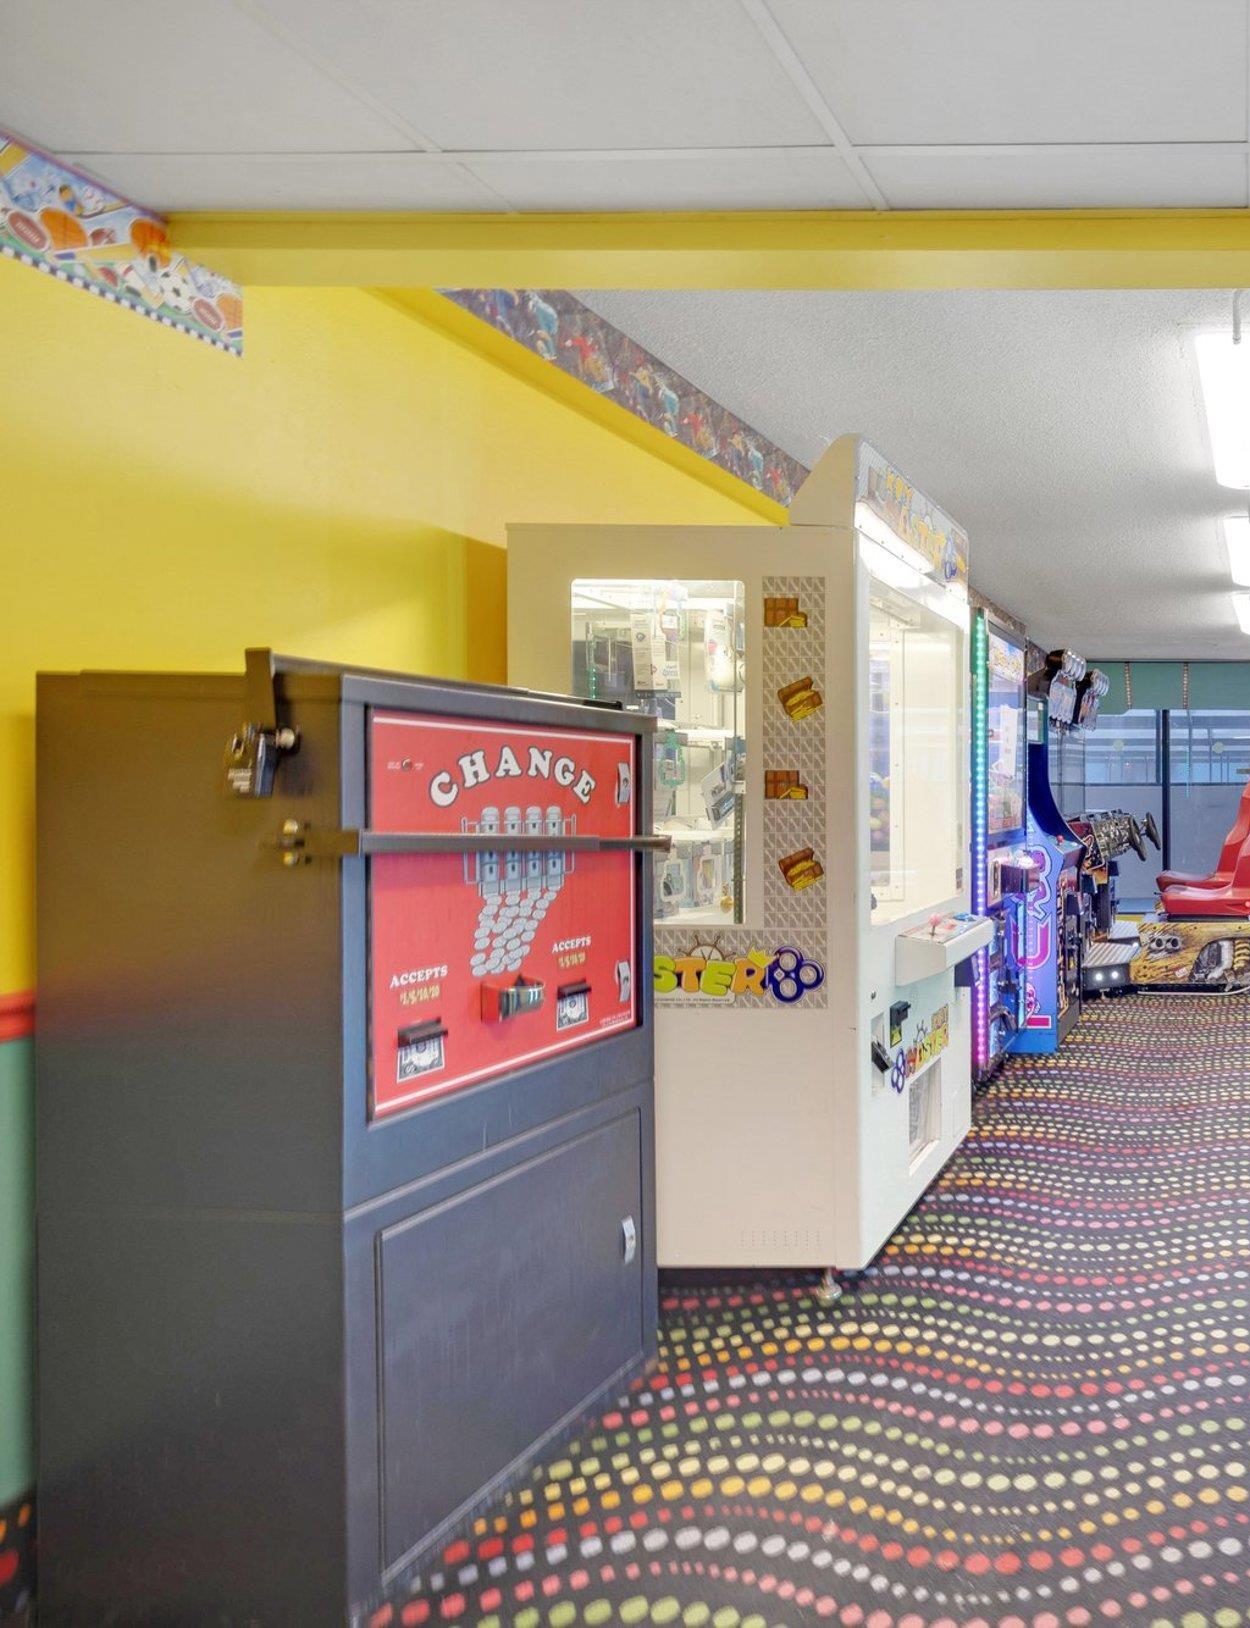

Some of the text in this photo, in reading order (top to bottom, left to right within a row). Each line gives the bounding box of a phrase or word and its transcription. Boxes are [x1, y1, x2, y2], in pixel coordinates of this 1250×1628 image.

[430, 746, 596, 807] CHANGE
[552, 936, 592, 953] ACCEPTS
[390, 964, 448, 989] ACCEPTS
[653, 955, 766, 996] STER
